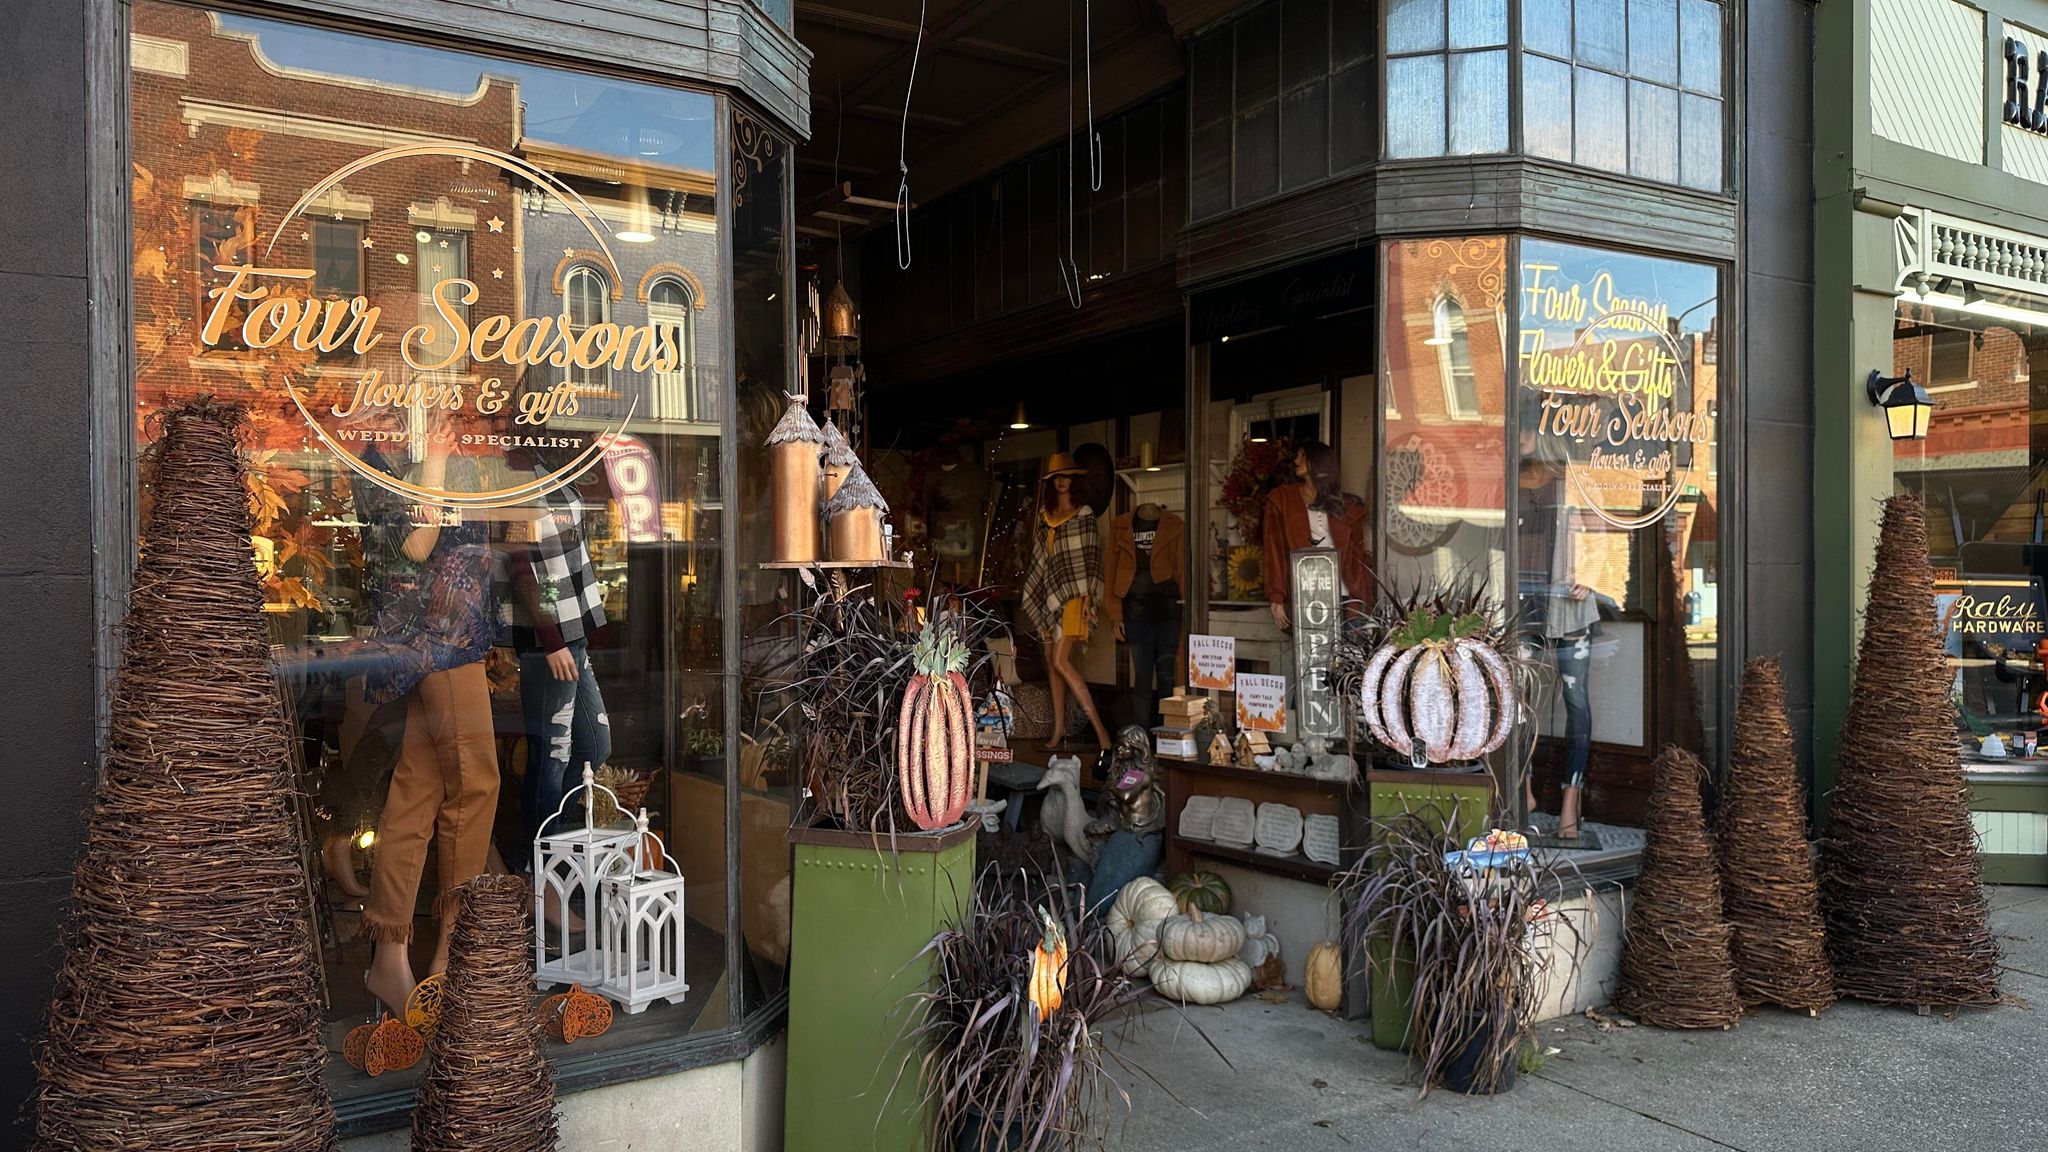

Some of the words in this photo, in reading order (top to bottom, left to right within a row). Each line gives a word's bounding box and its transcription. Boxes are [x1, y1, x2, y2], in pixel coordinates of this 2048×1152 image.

[201, 264, 383, 354] Four
[400, 278, 679, 374] Seasons
[1525, 263, 1587, 323] Four
[1588, 273, 1668, 335] Seasons
[331, 368, 464, 418] flowers
[476, 377, 509, 415] &
[515, 381, 579, 426] gifts
[1519, 329, 1594, 390] Flowers
[1596, 339, 1619, 393] &
[1622, 343, 1676, 420] Gifts
[337, 429, 447, 445] WEDDING
[461, 434, 583, 449] SPECIALIST
[1539, 388, 1601, 438] Four
[1607, 392, 1707, 446] Seasons
[1583, 446, 1629, 476] flowers
[1633, 449, 1646, 473] &
[1647, 450, 1671, 478] gifts
[614, 456, 656, 541] OP
[1951, 594, 2037, 627] Raby
[1953, 620, 2046, 634] HARDWARE
[1193, 640, 1209, 648] FALL
[1212, 639, 1233, 650] DECOR
[1305, 600, 1333, 726] OPEN
[1240, 678, 1258, 687] FALL
[1261, 678, 1284, 690] DECOR
[976, 750, 1010, 760] SSINGS
